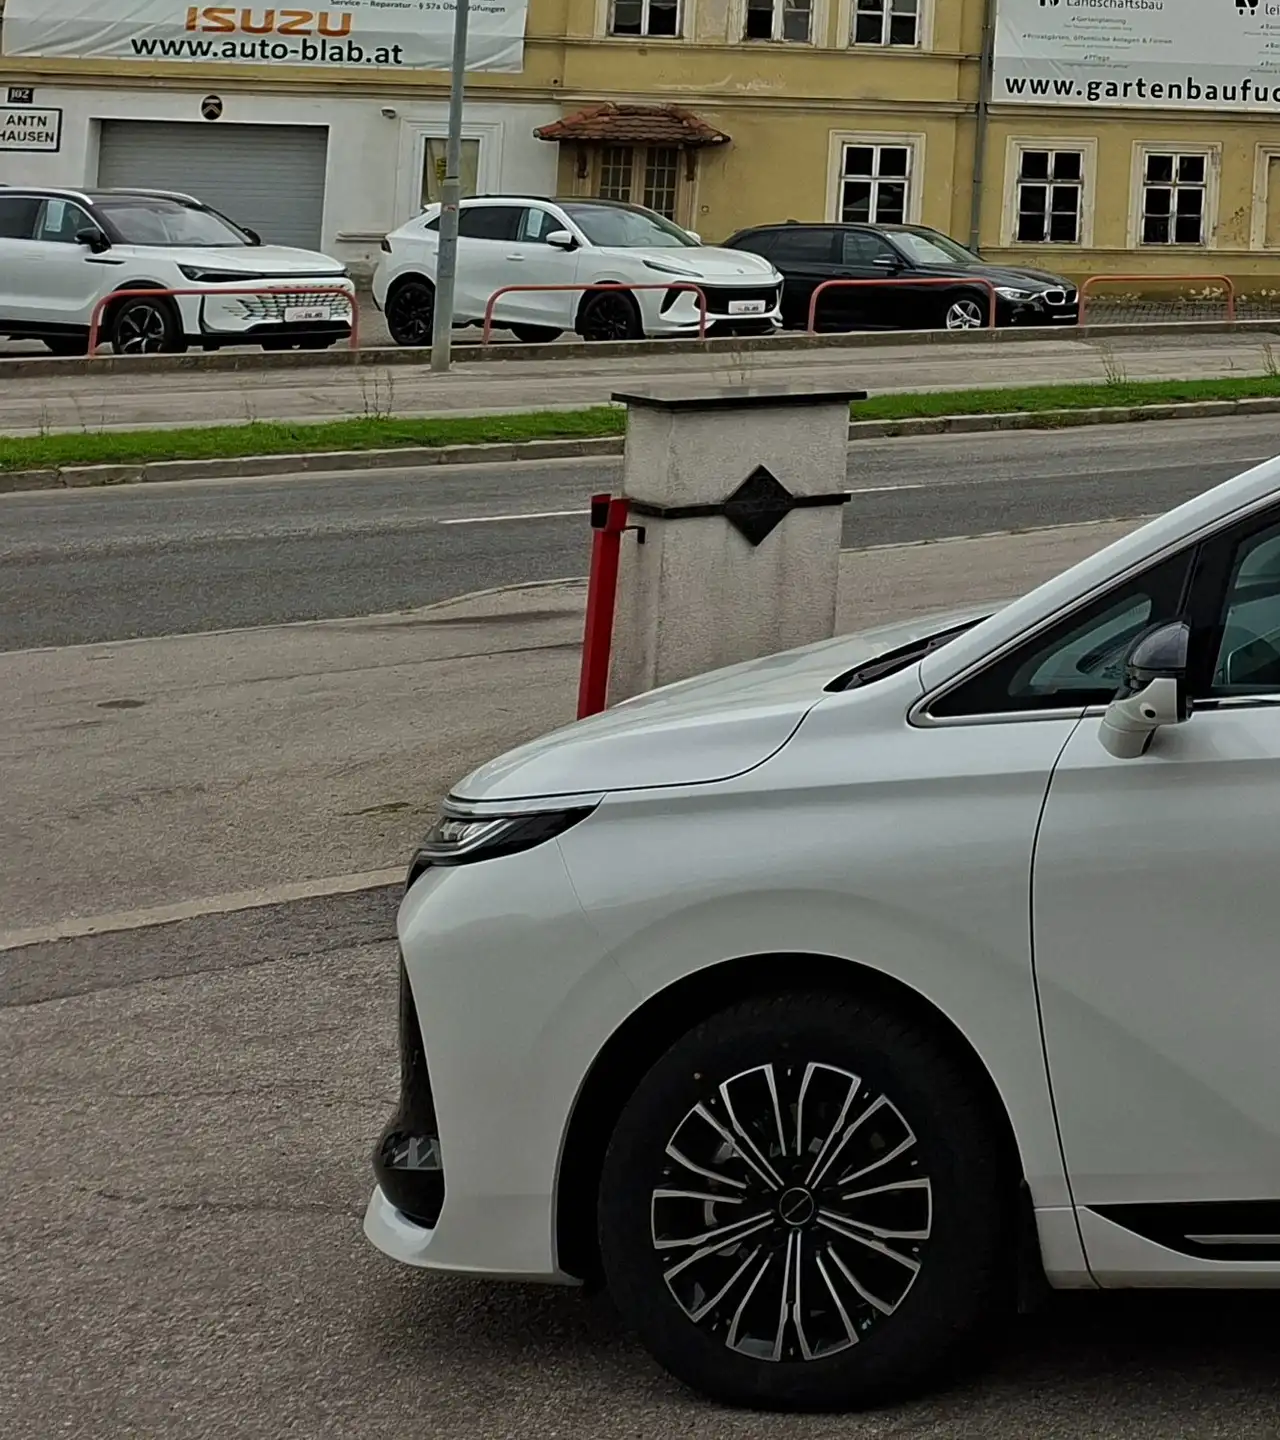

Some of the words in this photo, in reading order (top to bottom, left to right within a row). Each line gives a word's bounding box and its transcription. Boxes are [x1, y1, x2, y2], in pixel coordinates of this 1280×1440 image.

[370, 0, 412, 10] Reparatur
[185, 6, 353, 37] ISUZU
[131, 38, 403, 65] www.auto-blab.at
